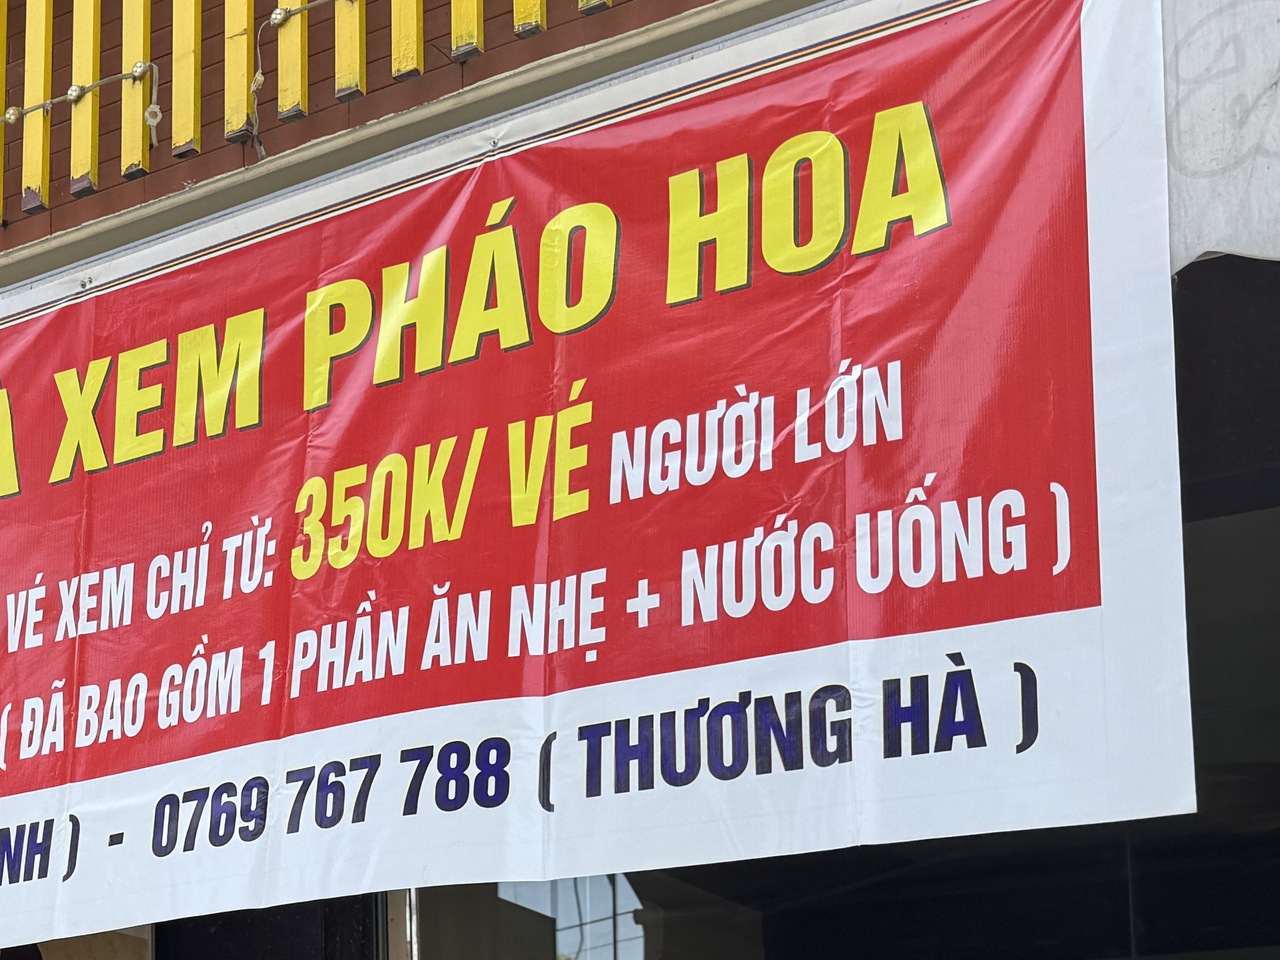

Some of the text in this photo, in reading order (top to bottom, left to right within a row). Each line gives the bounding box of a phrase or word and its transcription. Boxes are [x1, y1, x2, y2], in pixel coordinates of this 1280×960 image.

[48, 308, 265, 486] XEM
[303, 196, 619, 413] PHÁO
[665, 101, 951, 306] HOA
[6, 357, 904, 654] VÉ XEM CHỈ TỪ: 350K/ VÉ NGƯỜI LỚN
[19, 678, 65, 760] ĐÃ
[74, 672, 148, 749] BAO
[157, 633, 243, 726] GỒM
[257, 639, 276, 707] 1
[290, 589, 410, 699] PHẦN
[420, 580, 492, 671] ĂN
[507, 566, 608, 663] NHẸ
[625, 578, 661, 628] +
[680, 513, 834, 627] NƯỚC
[855, 472, 1027, 594] UỐNG
[1050, 481, 1071, 576] )
[62, 814, 82, 883] )
[107, 830, 125, 848] -
[151, 775, 269, 858] 0769
[285, 753, 382, 835] 767
[399, 736, 511, 817] 788
[538, 731, 557, 812] (
[577, 684, 853, 798] THƯƠNG
[882, 652, 988, 759] HÀ
[1015, 662, 1039, 755] )
